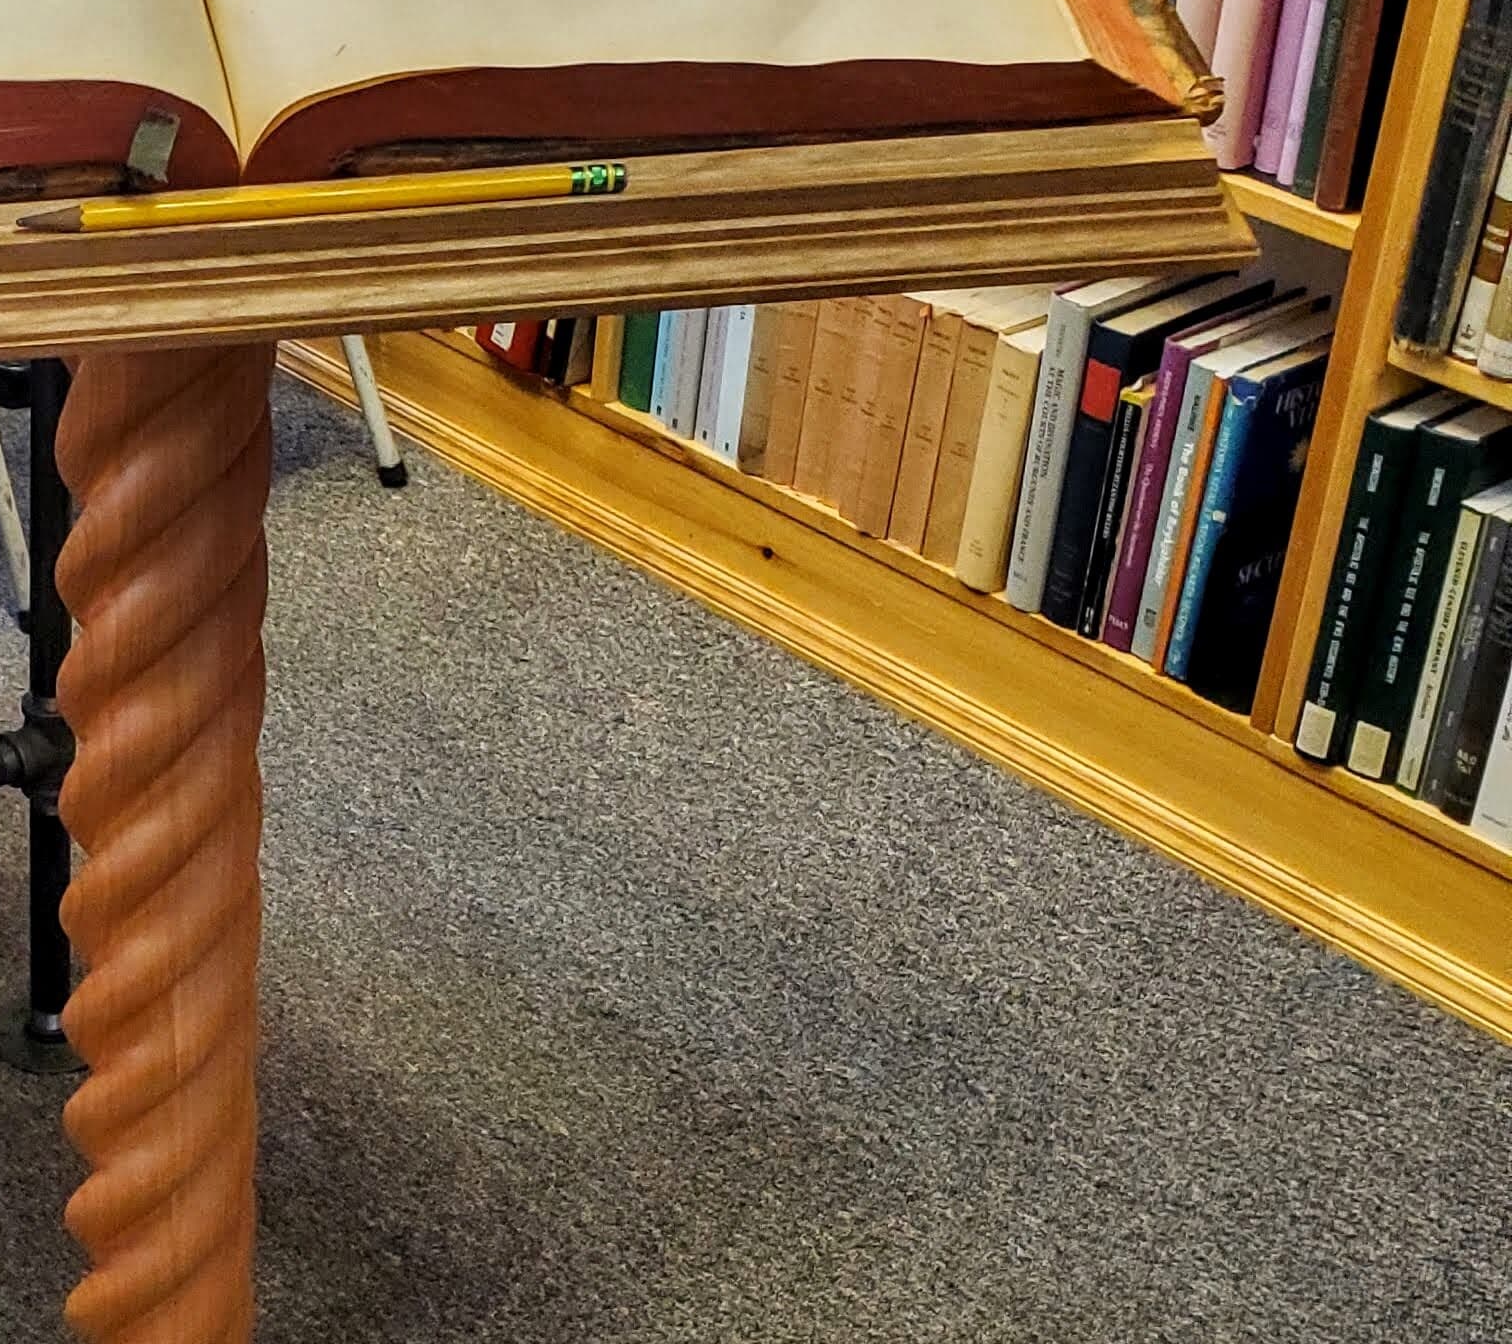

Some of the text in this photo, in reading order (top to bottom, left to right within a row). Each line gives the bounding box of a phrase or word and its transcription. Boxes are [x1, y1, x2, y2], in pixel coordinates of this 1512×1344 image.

[1179, 441, 1193, 463] The
[1172, 465, 1188, 498] Book
[1168, 499, 1182, 515] of
